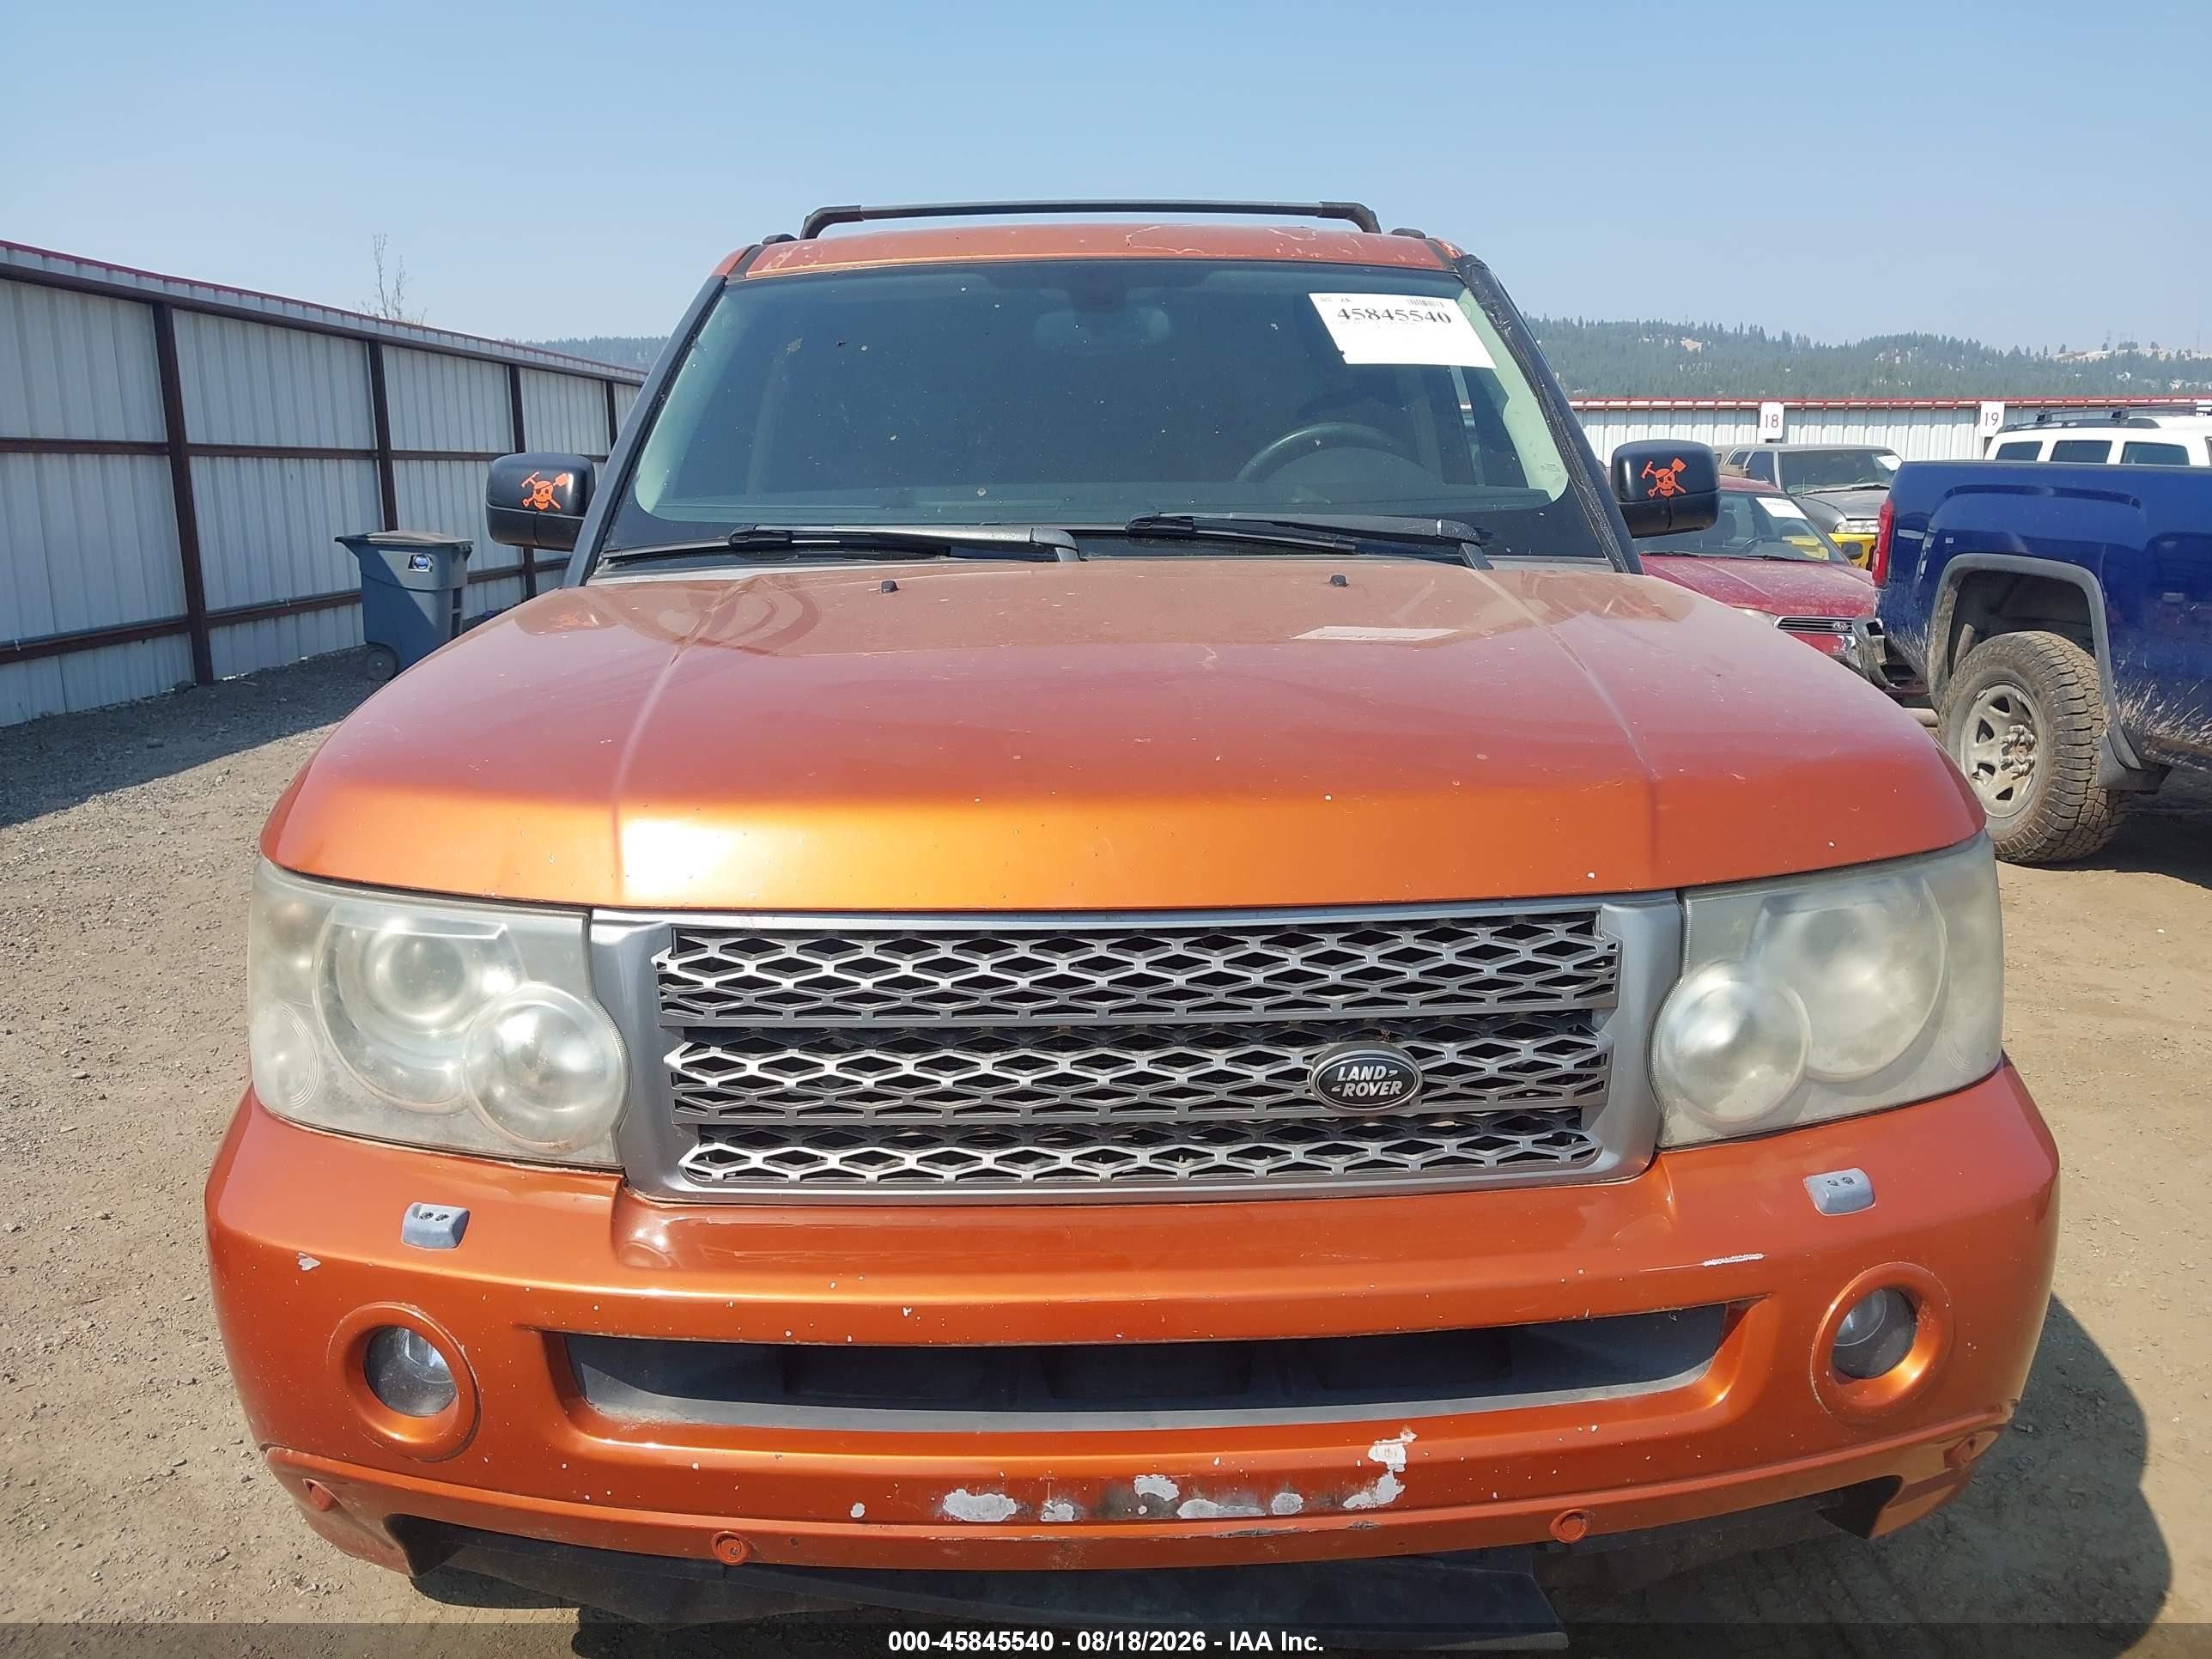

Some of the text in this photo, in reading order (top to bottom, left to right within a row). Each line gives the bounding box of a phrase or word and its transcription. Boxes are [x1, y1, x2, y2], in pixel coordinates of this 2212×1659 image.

[1337, 308, 1451, 323] 45845540
[1765, 414, 1778, 428] 18
[1985, 412, 1999, 426] 19
